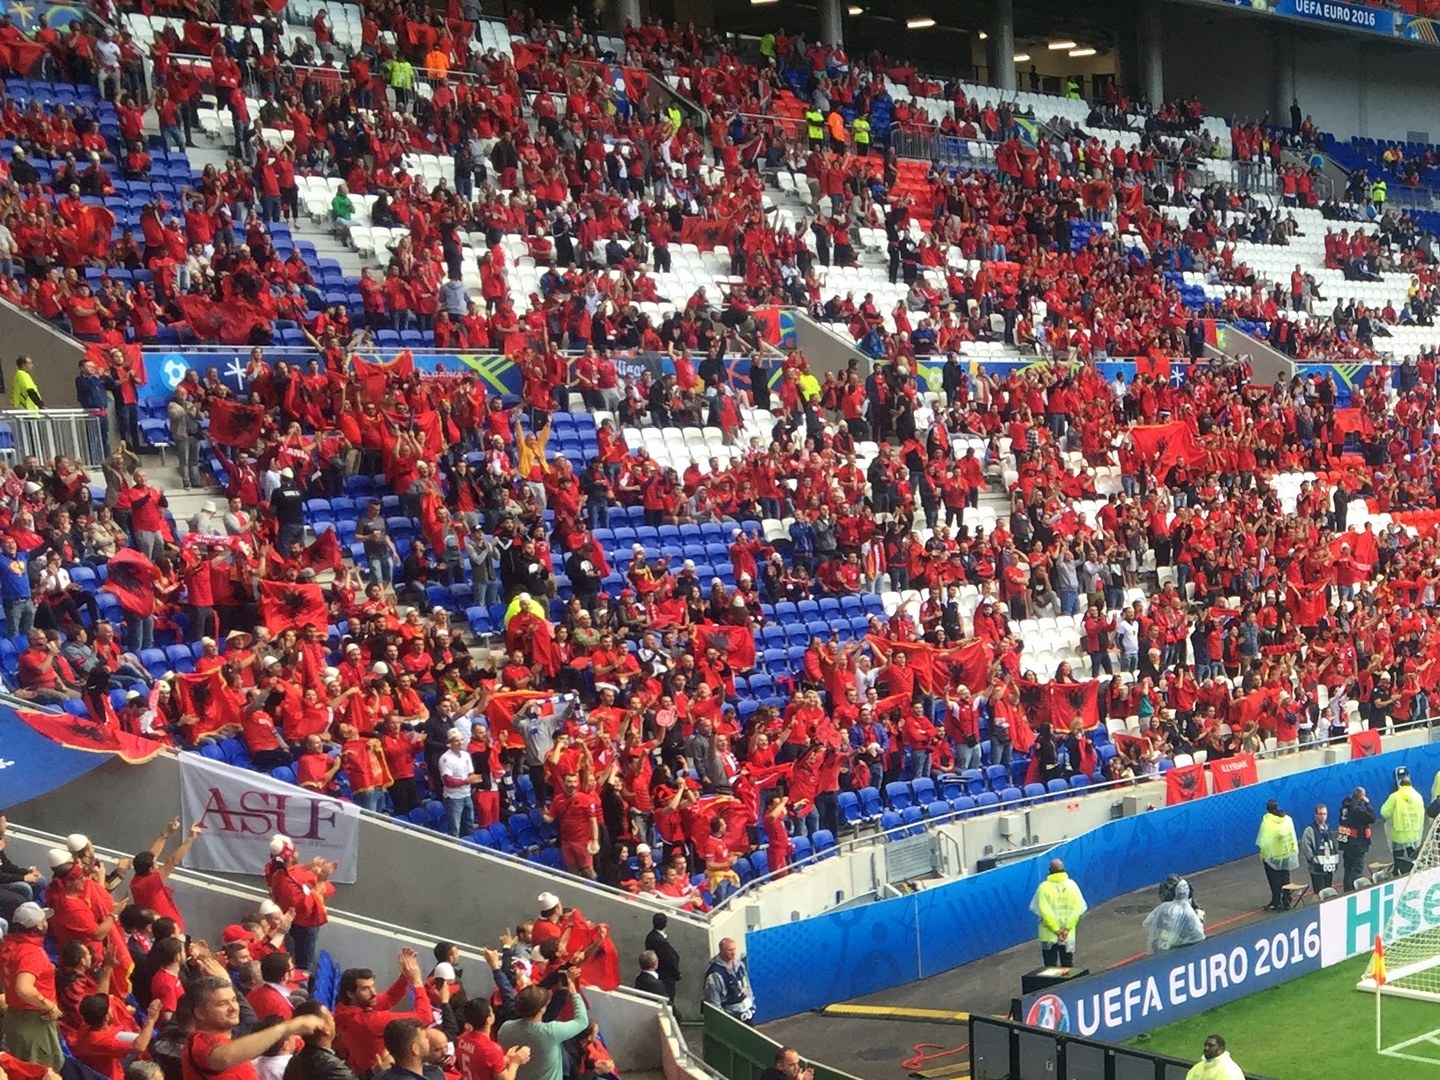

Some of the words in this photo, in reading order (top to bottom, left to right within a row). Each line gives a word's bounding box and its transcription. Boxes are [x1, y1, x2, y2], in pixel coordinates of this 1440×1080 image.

[1295, 0, 1322, 16] UEFA
[1324, 4, 1350, 21] EURO
[1352, 9, 1376, 26] 2016
[1078, 976, 1163, 1036] UEFA
[1169, 946, 1248, 1006] EURO
[1254, 921, 1321, 977] 2016
